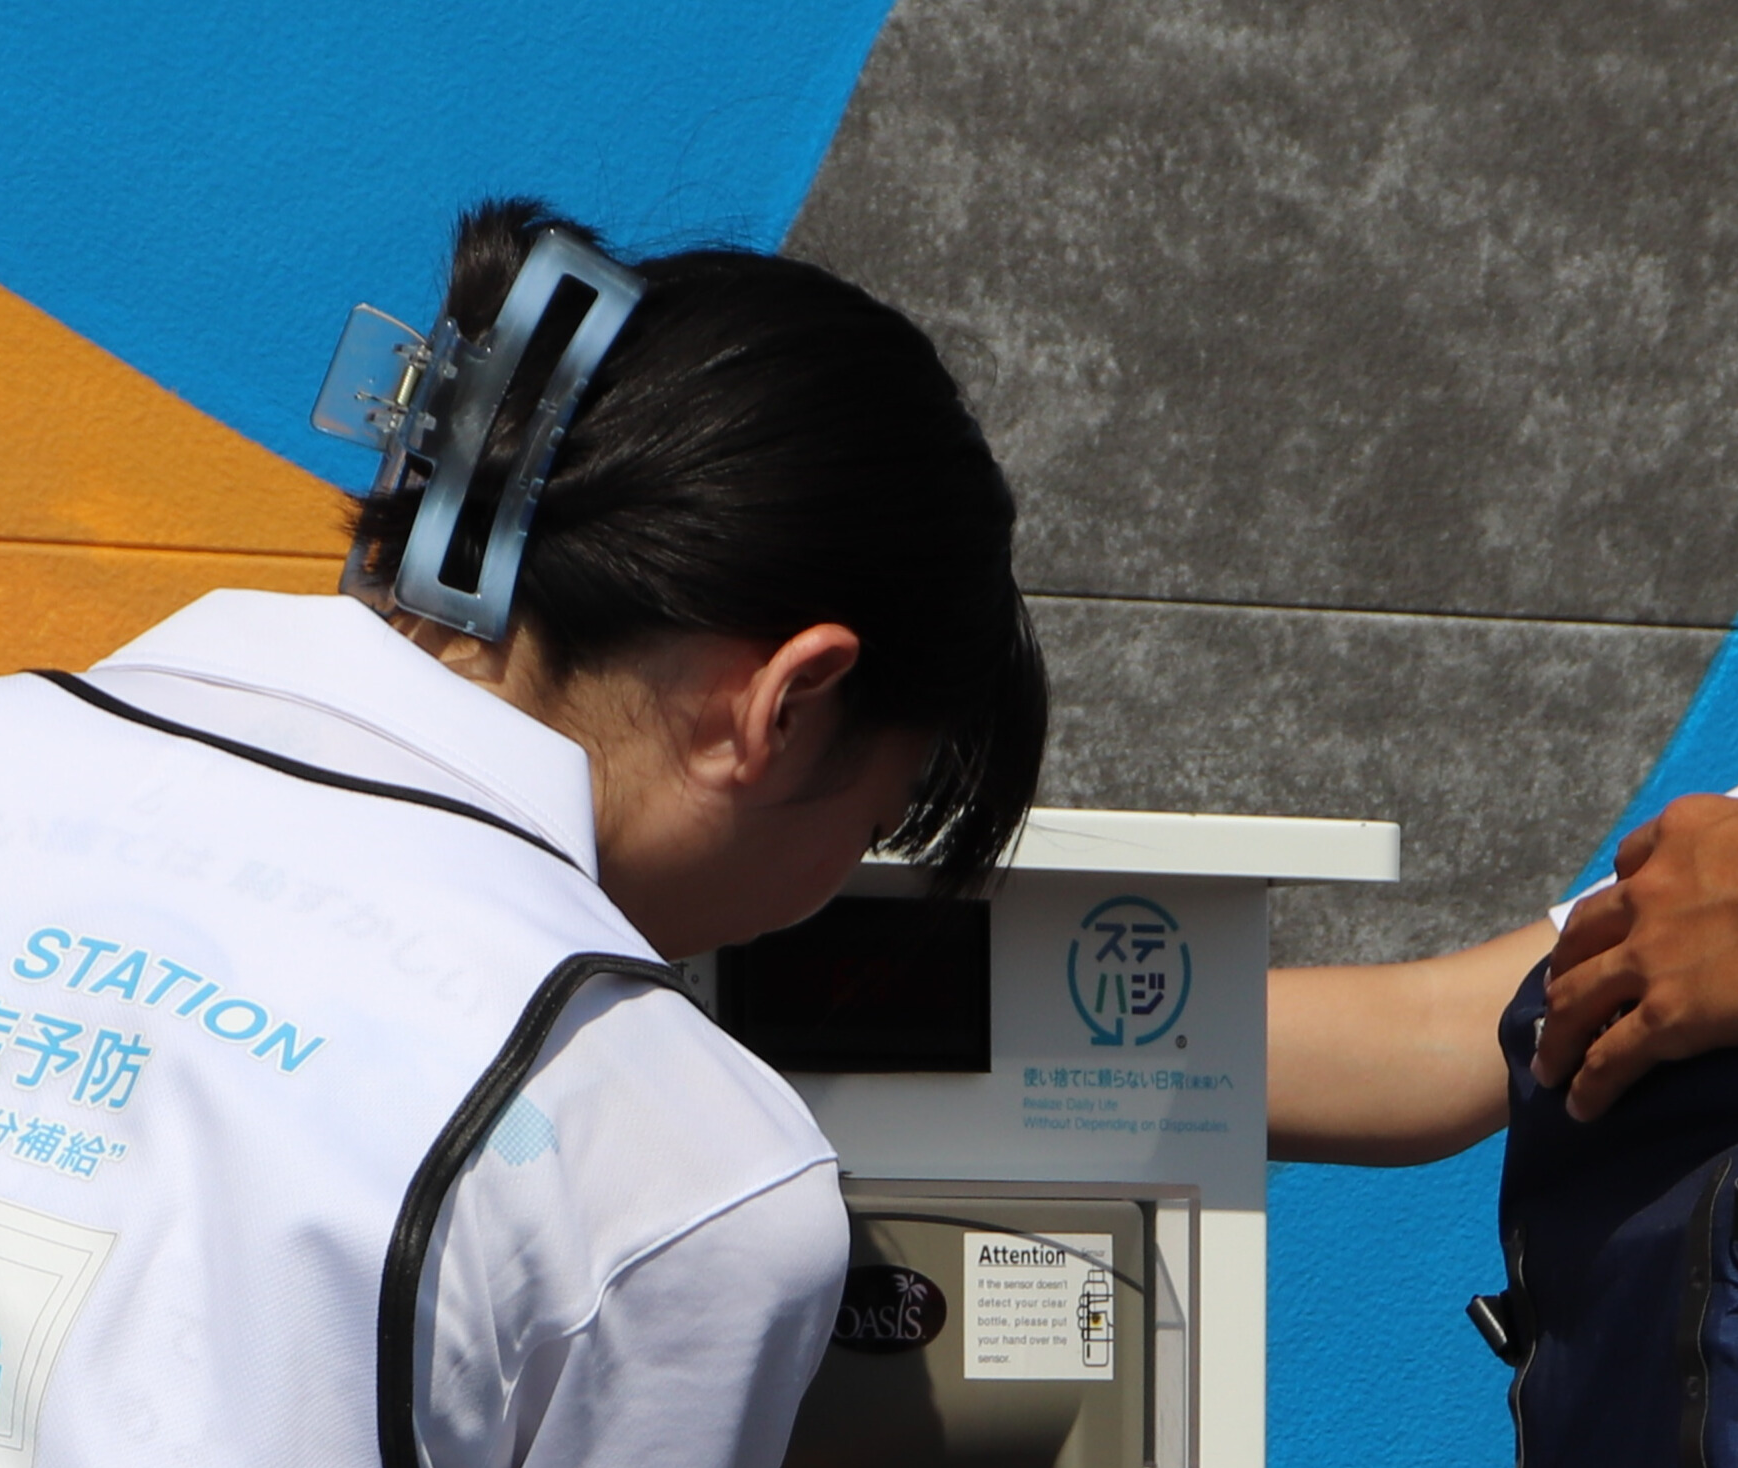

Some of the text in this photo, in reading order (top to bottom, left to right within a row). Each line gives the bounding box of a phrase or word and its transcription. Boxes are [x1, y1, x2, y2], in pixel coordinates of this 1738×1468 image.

[13, 928, 326, 1073] STATION
[1022, 1097, 1062, 1110] Realize
[1066, 1098, 1095, 1112] Daily
[1023, 1116, 1071, 1130] Without
[1075, 1117, 1137, 1134] Depending
[1141, 1120, 1156, 1131] on
[979, 1243, 1066, 1265] Attention
[986, 1279, 1002, 1289] the
[1004, 1281, 1034, 1289] sensor
[978, 1297, 1067, 1310] detect your clear
[833, 1290, 922, 1340] OASIS
[1014, 1317, 1048, 1329] please
[1051, 1317, 1067, 1329] put
[977, 1335, 1067, 1348] your hand over the
